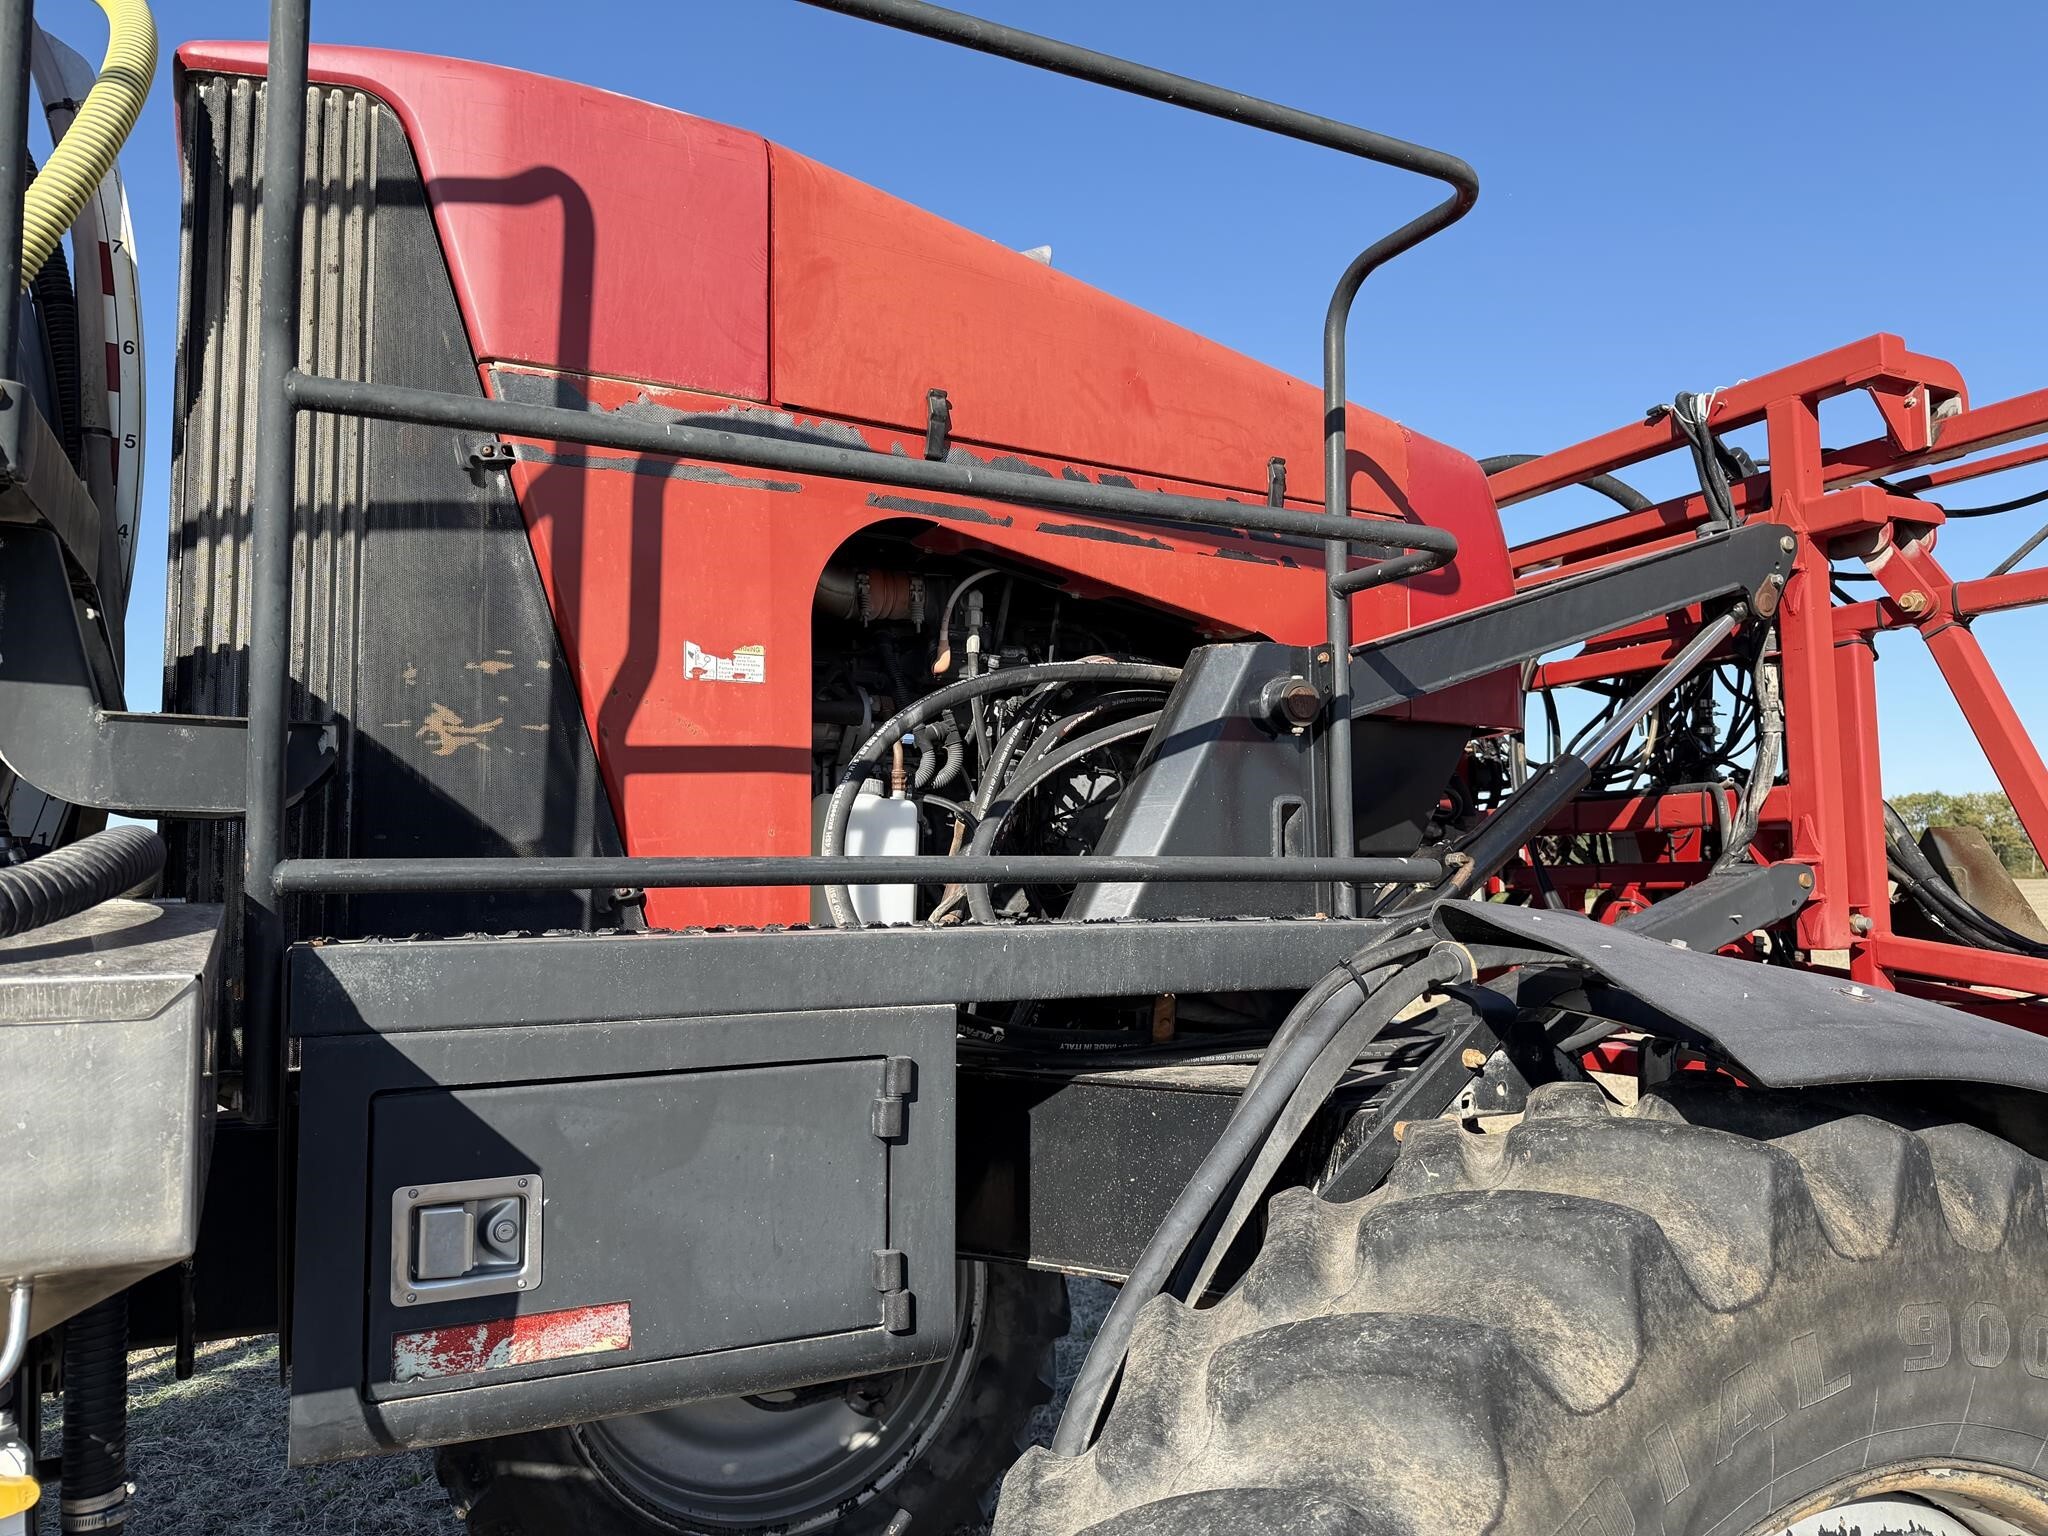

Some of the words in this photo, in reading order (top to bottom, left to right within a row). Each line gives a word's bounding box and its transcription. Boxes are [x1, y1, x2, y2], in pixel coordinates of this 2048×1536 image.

[112, 239, 123, 253] 7
[123, 340, 135, 355] 6
[124, 433, 137, 449] 5
[118, 523, 129, 539] 4
